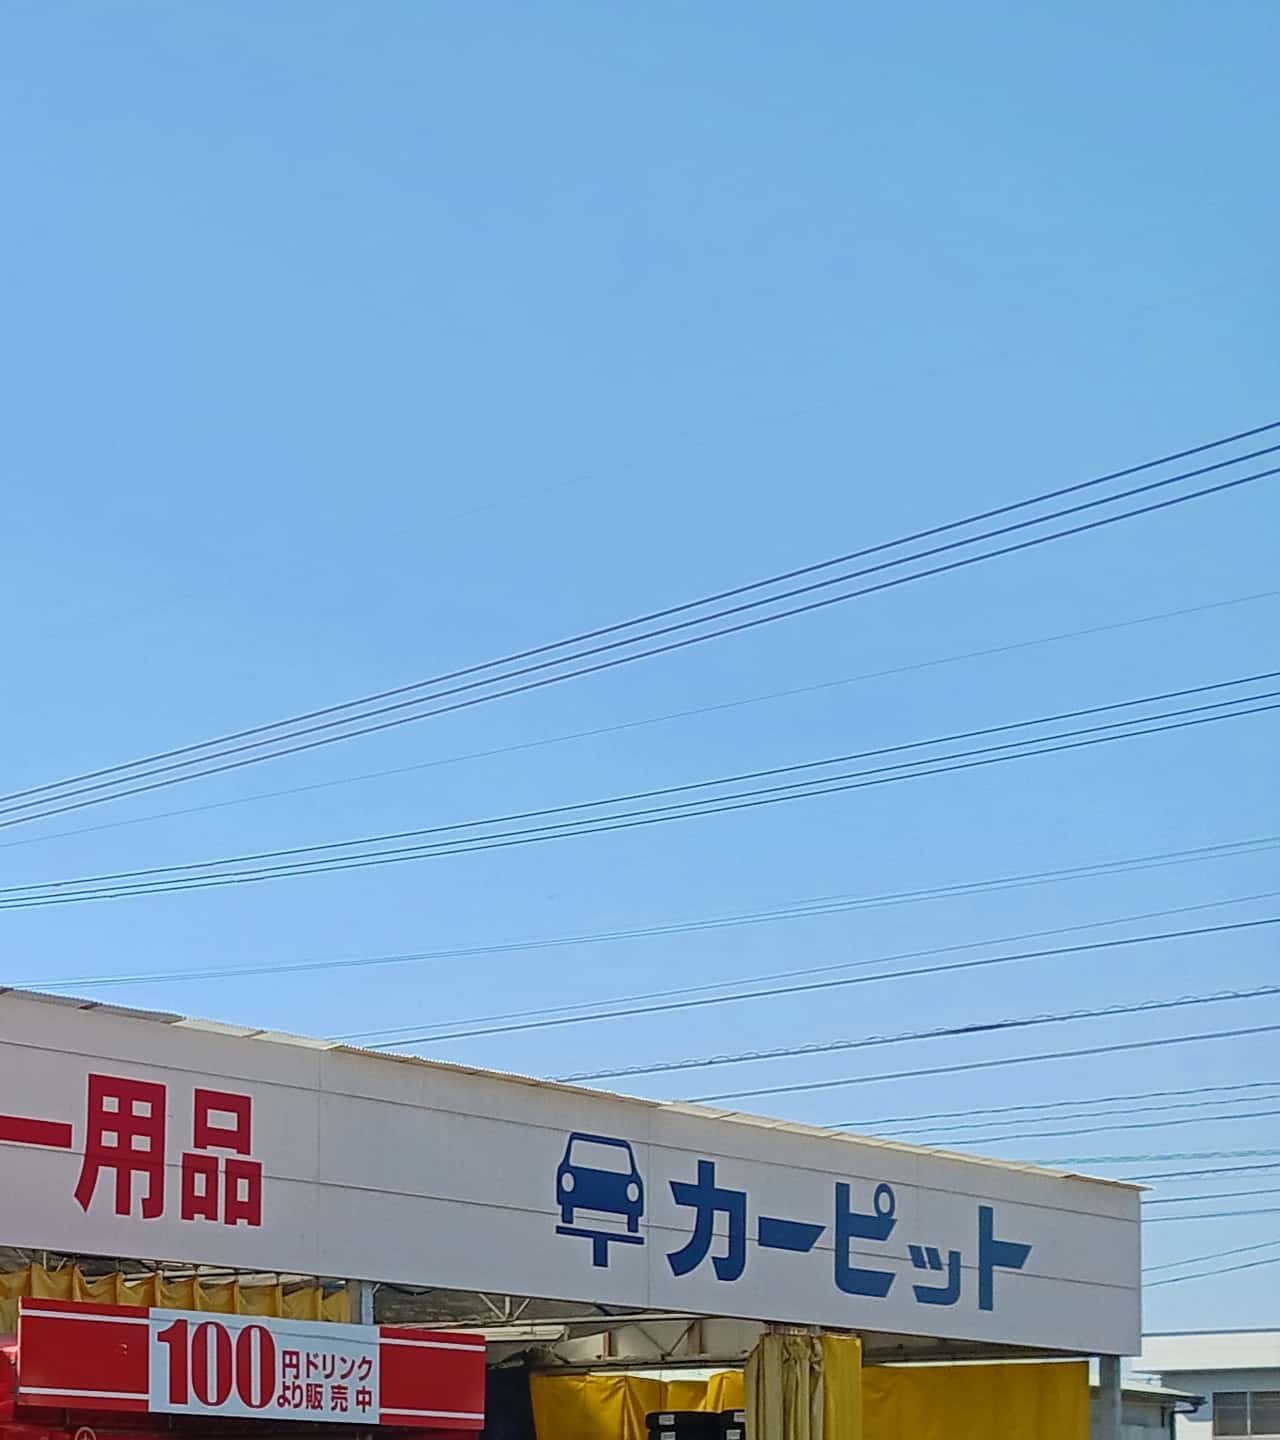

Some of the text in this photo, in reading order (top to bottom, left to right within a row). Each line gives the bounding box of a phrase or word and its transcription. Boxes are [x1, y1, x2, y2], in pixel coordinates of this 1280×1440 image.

[666, 1159, 1033, 1311] カーピット
[156, 1319, 373, 1409] 100 円ドリンク
[276, 1381, 373, 1413] より販売中
